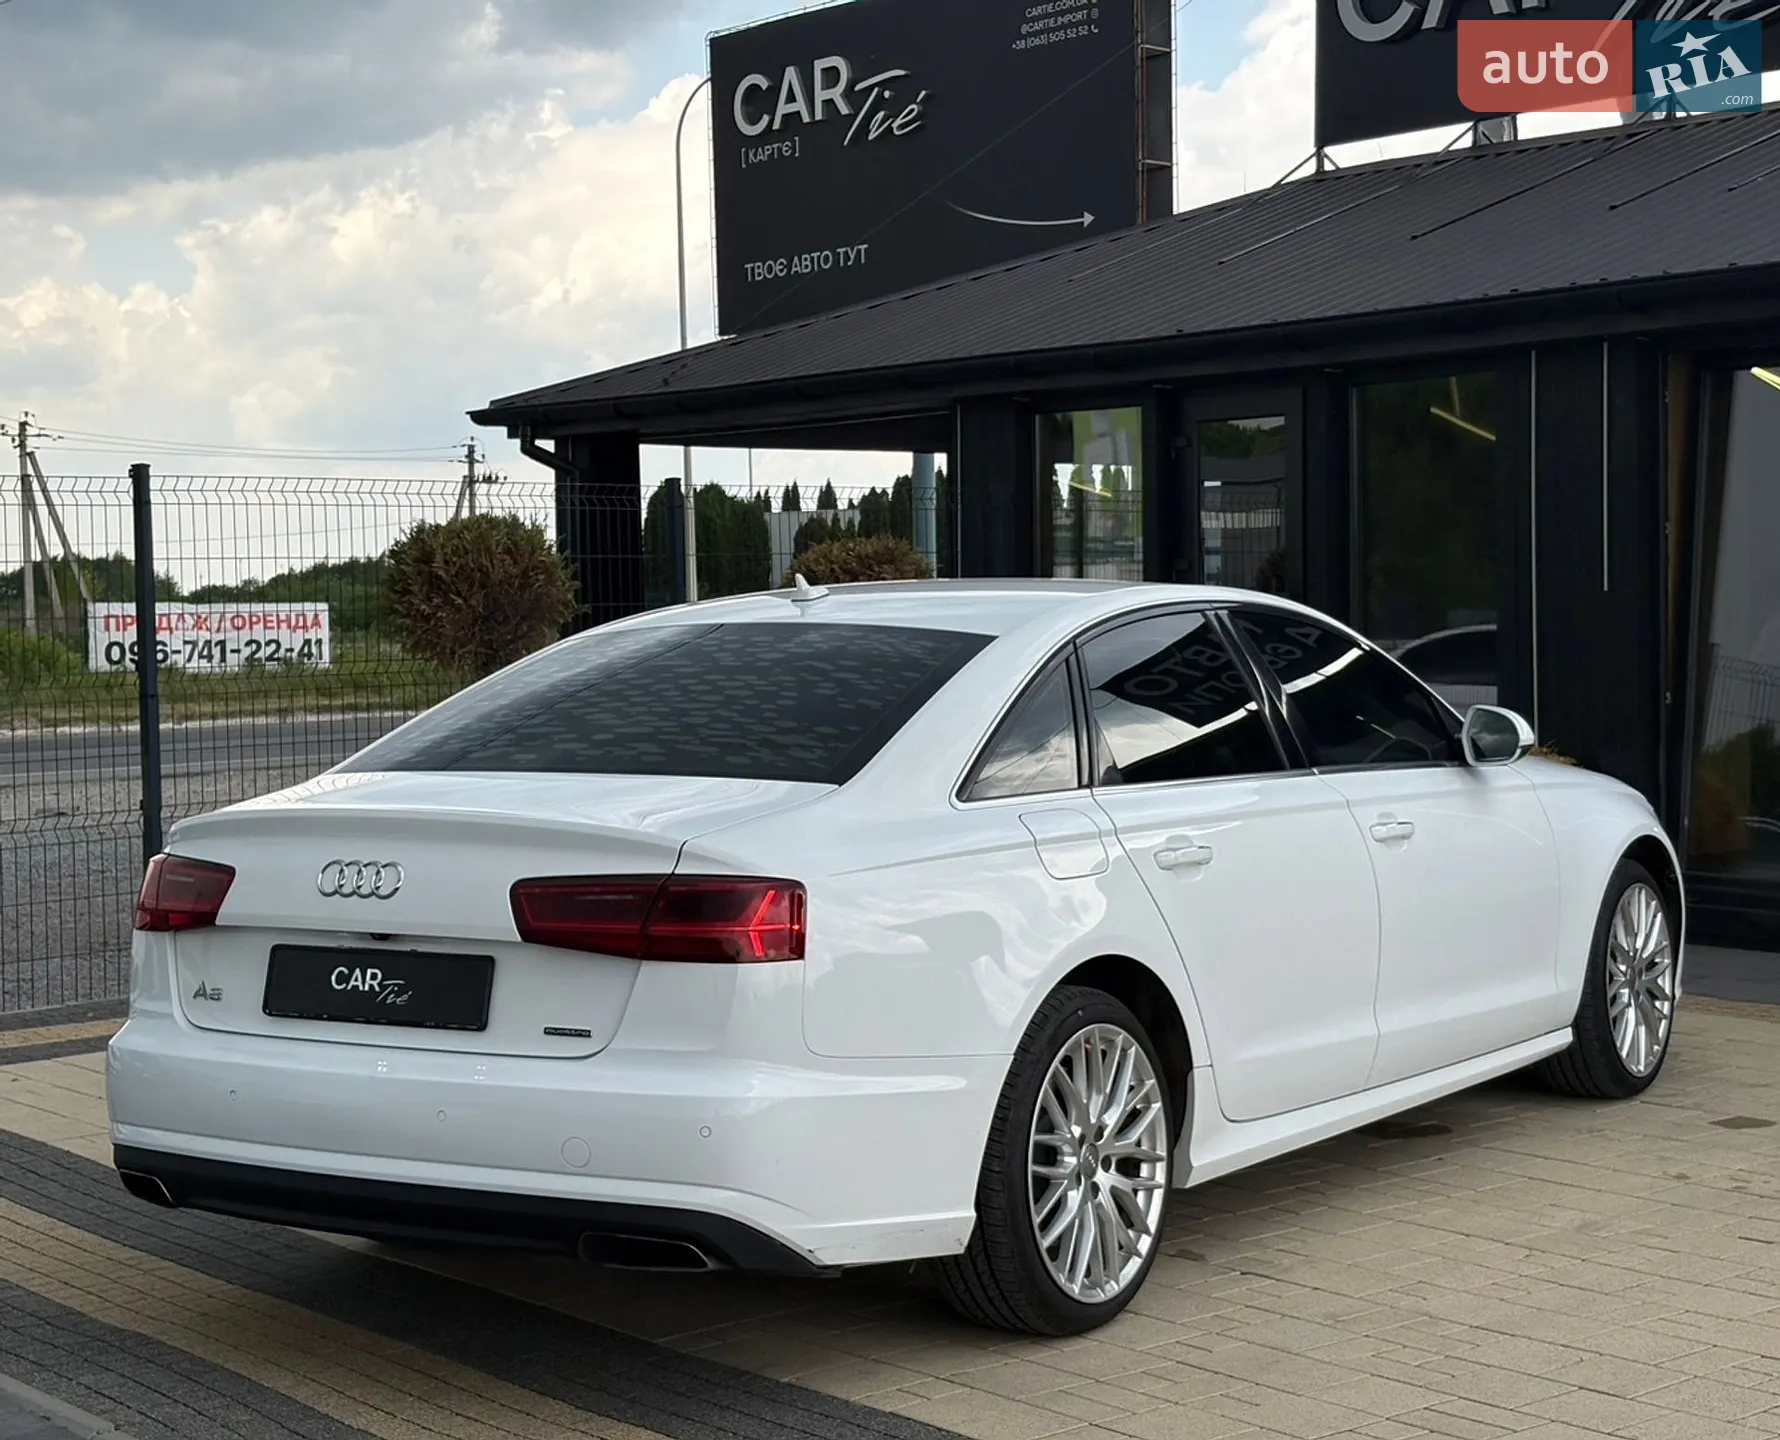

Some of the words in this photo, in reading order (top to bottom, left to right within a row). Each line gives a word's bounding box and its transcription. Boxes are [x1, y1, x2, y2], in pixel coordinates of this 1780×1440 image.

[1049, 30, 1065, 42] 505
[1066, 28, 1077, 38] 52
[1078, 25, 1089, 36] 52
[733, 55, 853, 136] CAR
[744, 258, 787, 282] ТВОЄ
[790, 252, 833, 275] АВТО
[836, 244, 869, 267] ТУТ
[103, 613, 211, 634] ПРДАЖ
[230, 613, 322, 633] ОРЕНДА
[331, 966, 382, 991] CAR
